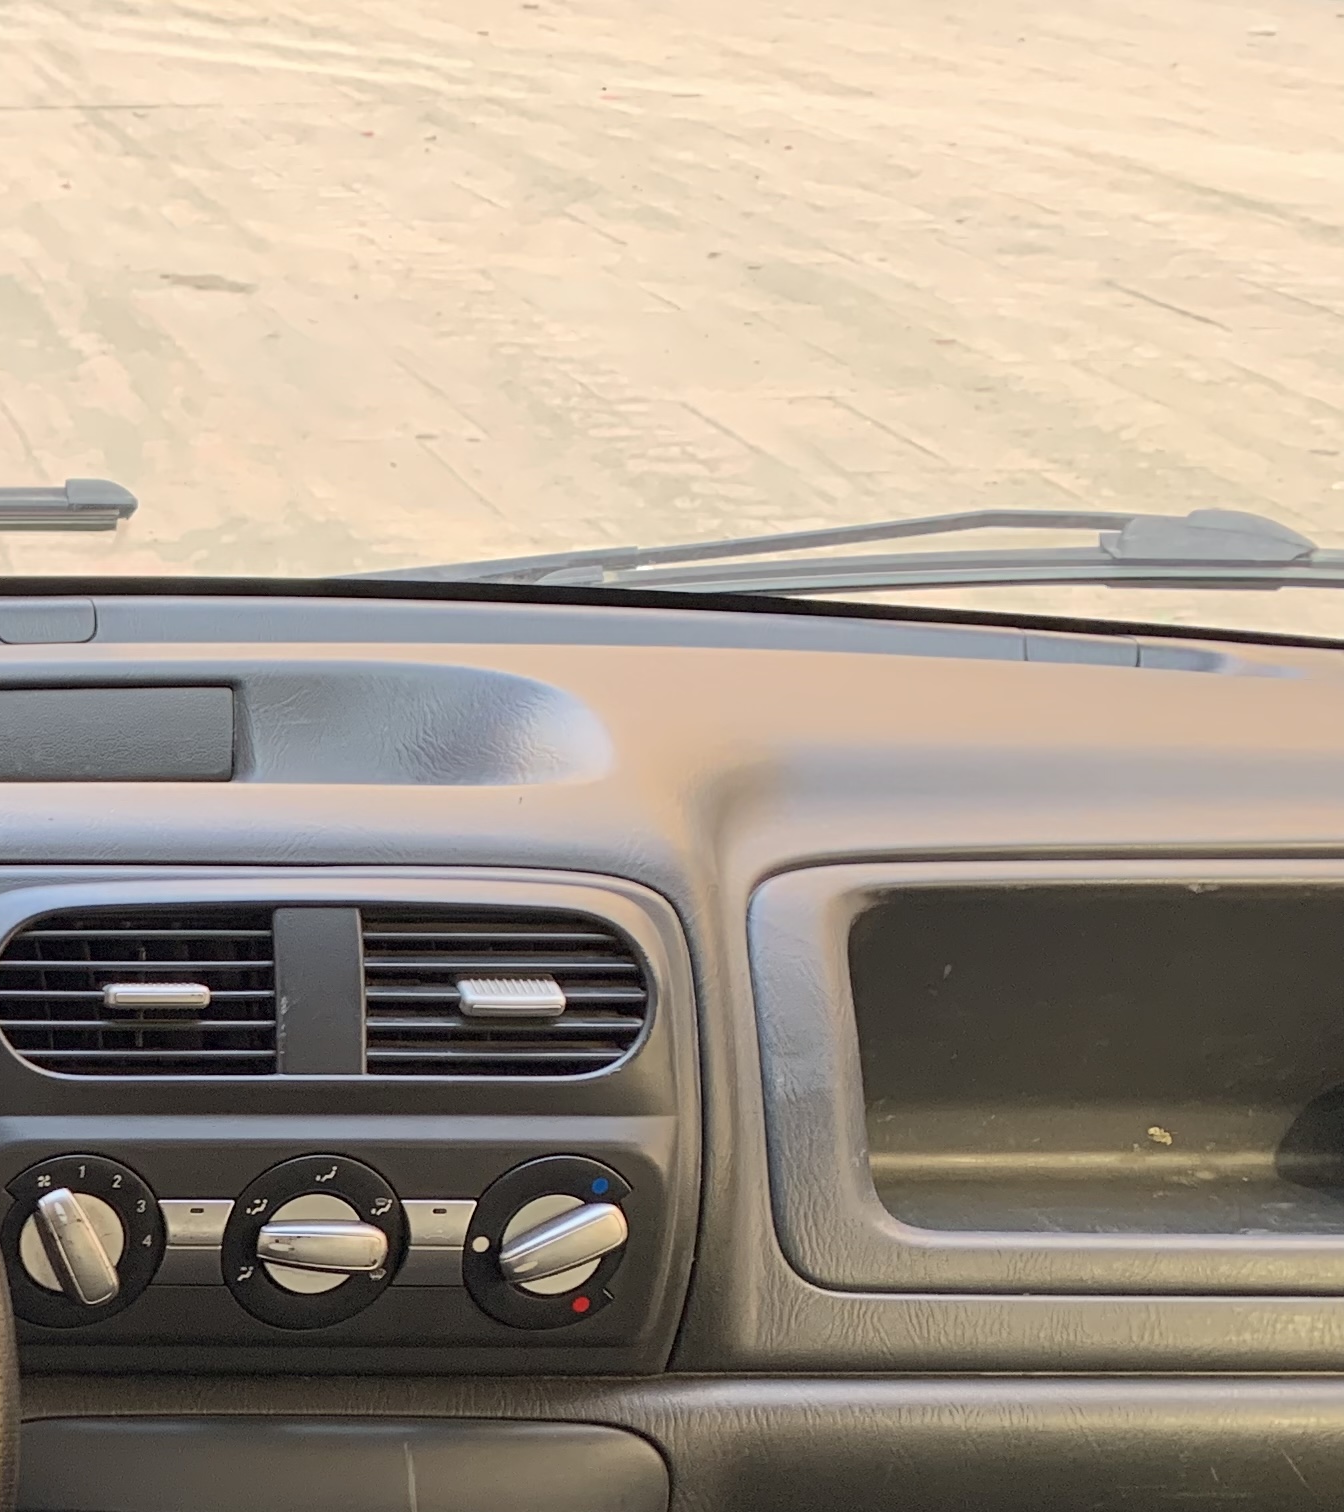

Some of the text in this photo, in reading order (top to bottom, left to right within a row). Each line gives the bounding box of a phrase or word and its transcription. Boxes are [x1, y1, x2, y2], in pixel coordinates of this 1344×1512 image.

[78, 1165, 86, 1178] 1
[112, 1174, 122, 1188] 2
[136, 1199, 147, 1213] 3
[142, 1234, 152, 1247] 4
